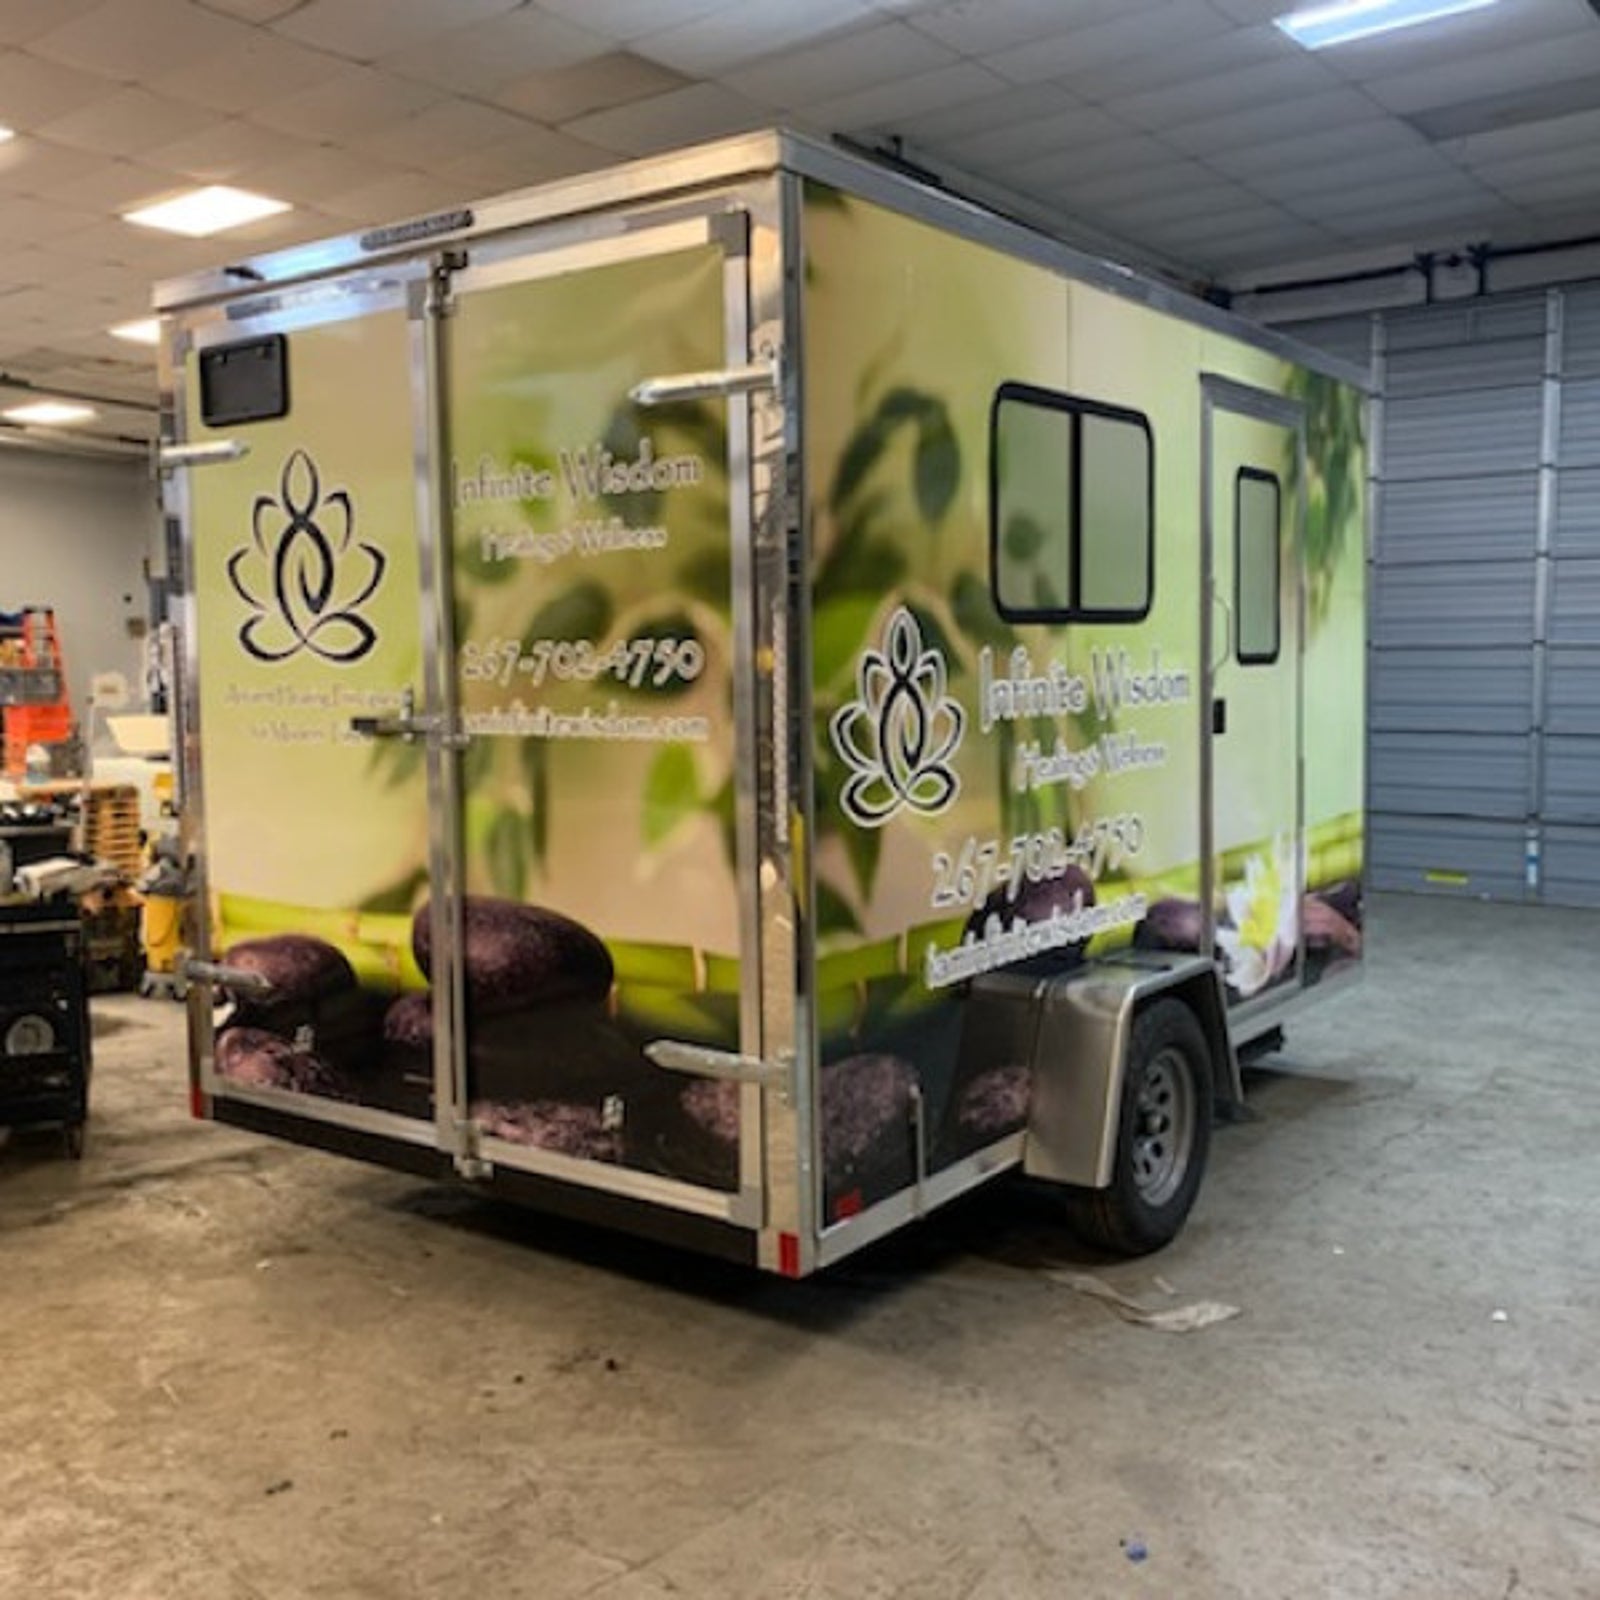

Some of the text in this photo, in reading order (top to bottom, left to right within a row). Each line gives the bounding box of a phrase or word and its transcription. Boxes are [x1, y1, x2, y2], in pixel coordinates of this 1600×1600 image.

[558, 438, 703, 501] Wisdom
[461, 638, 705, 689] 267-702-4750
[979, 644, 1190, 733] Infinite Wisdom
[930, 812, 1145, 910] 267-702-4750
